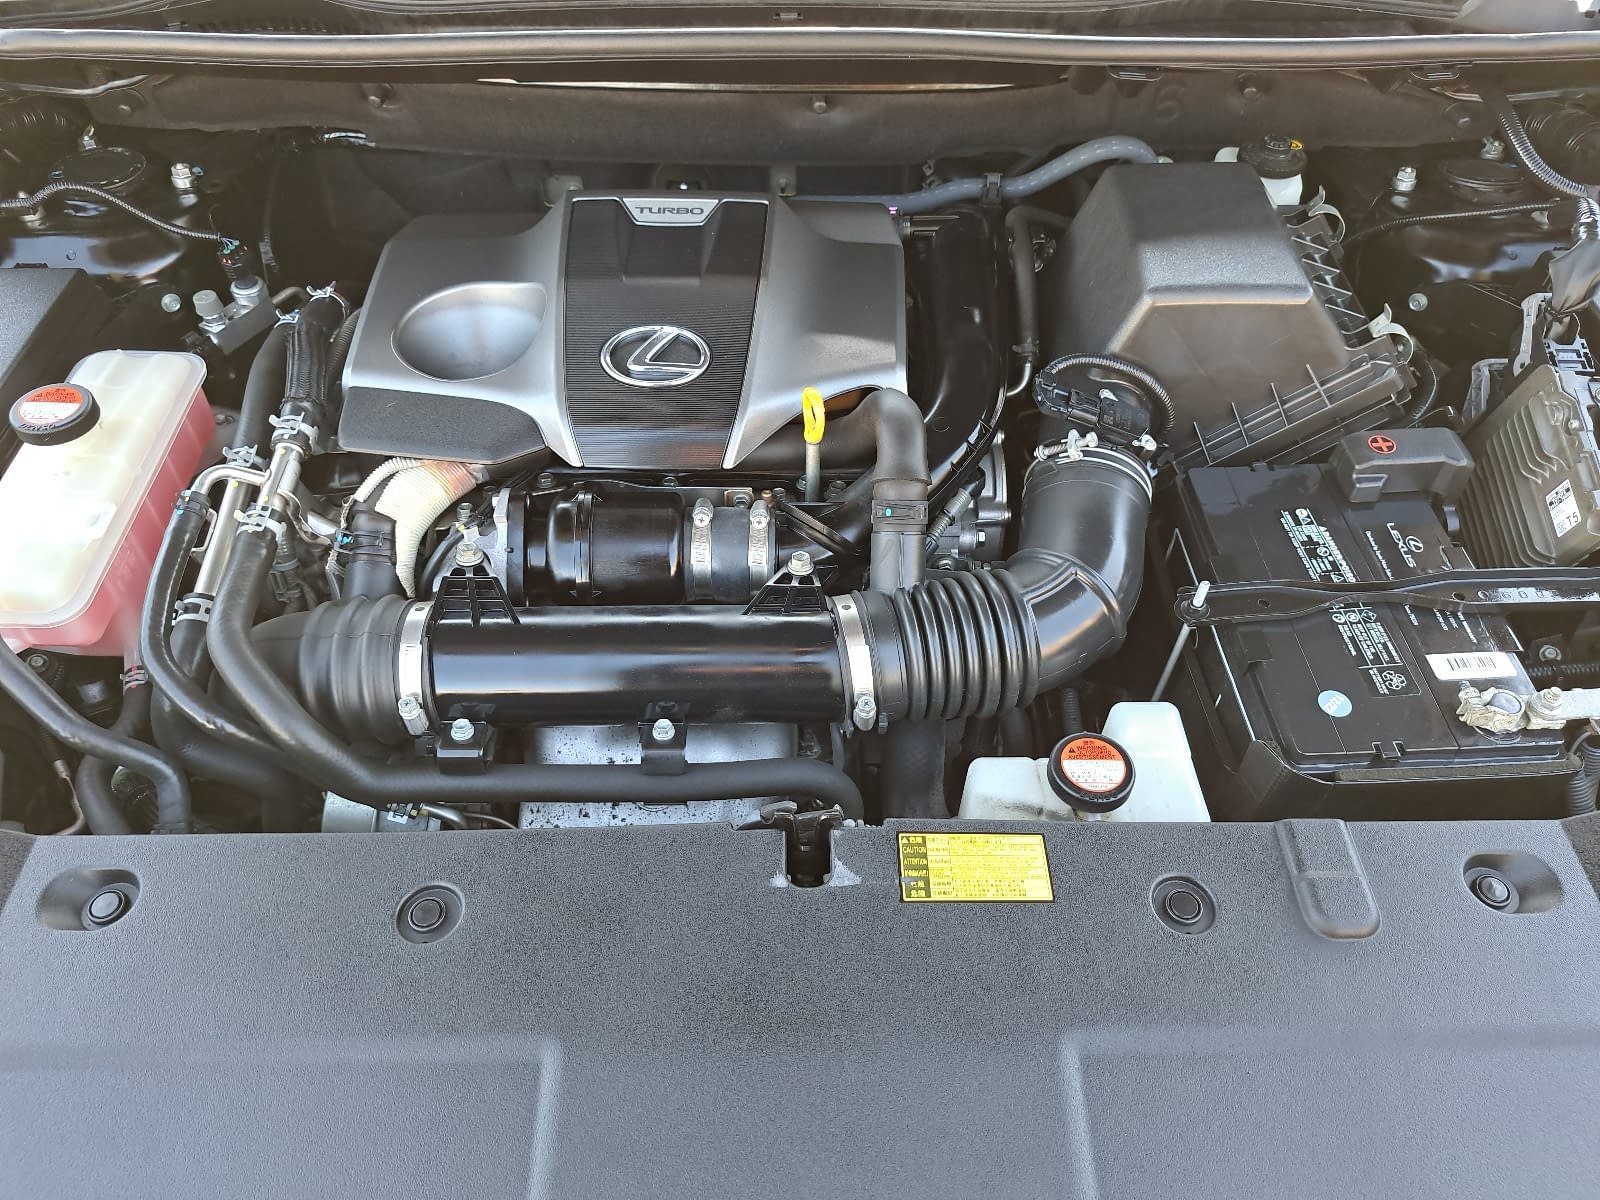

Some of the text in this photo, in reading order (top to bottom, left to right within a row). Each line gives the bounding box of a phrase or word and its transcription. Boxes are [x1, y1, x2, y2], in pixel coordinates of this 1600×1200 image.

[635, 207, 704, 215] TURBO
[1387, 523, 1416, 567] LEXUS
[902, 846, 927, 854] CAUTION
[904, 858, 928, 866] ATTENTION
